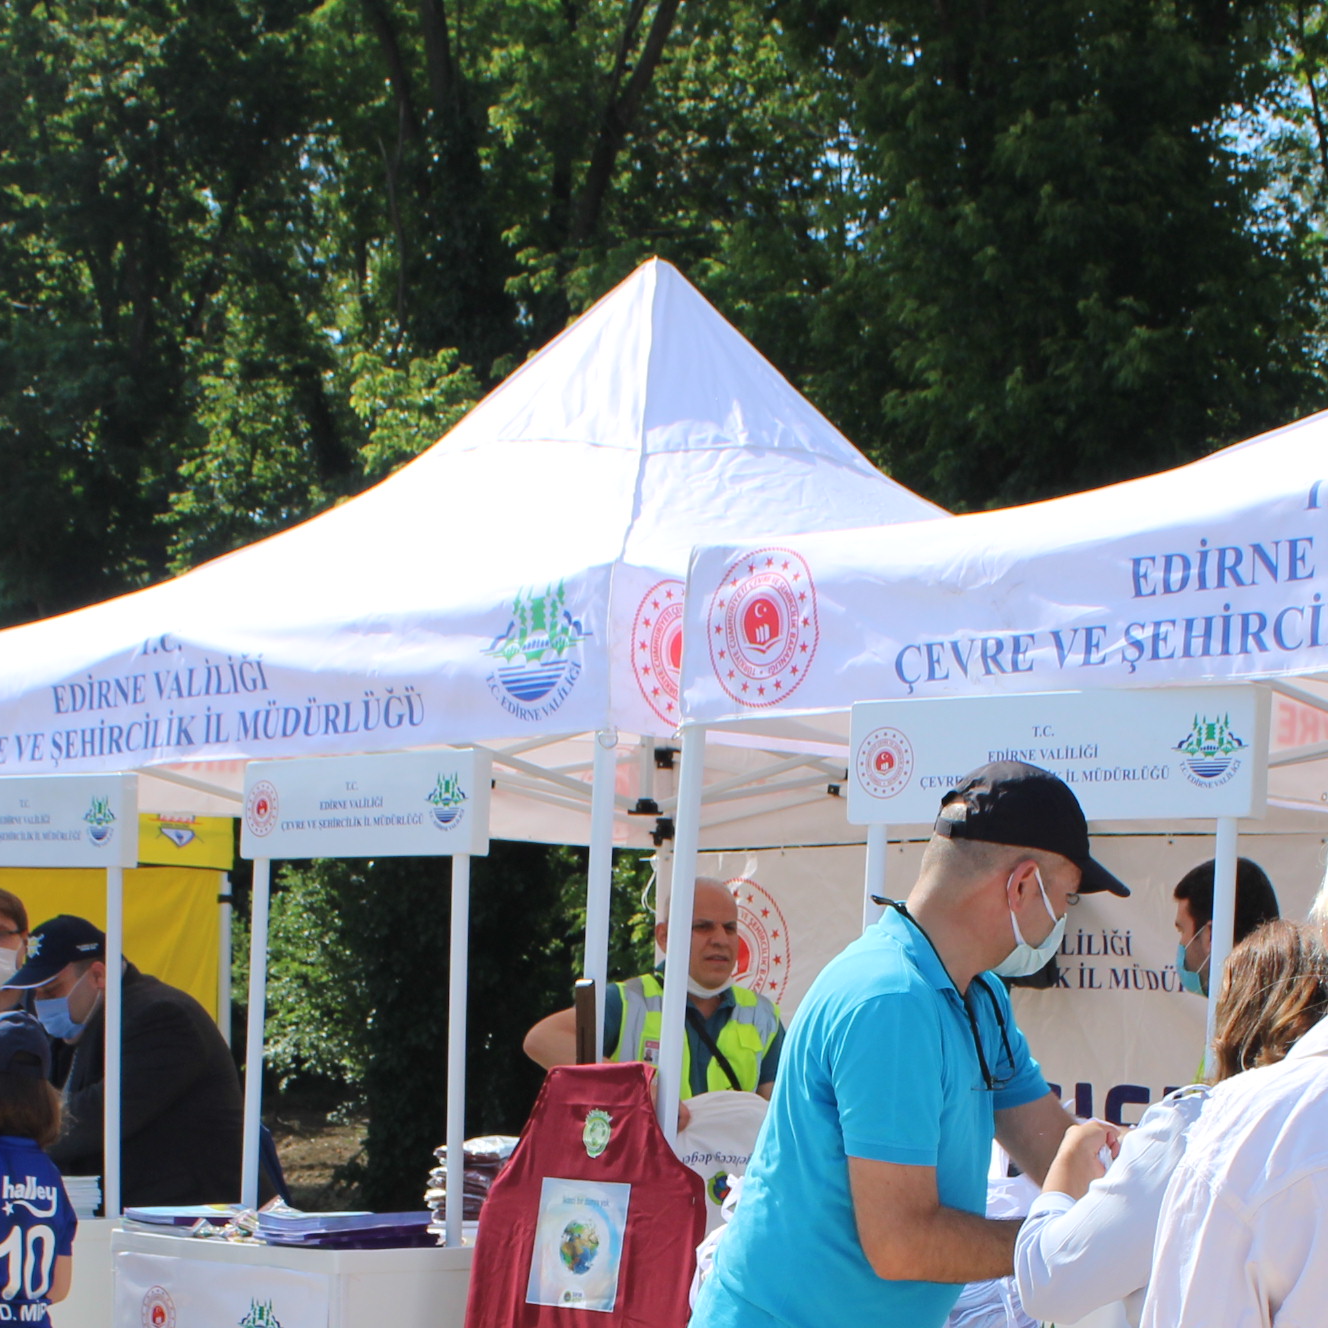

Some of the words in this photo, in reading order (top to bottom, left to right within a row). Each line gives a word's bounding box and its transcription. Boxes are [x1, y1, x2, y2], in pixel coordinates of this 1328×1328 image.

[1131, 535, 1315, 599] EDİRNE
[52, 674, 146, 714] EDİRNE
[153, 653, 270, 701] VALİLİĞİ
[895, 634, 1035, 695] ÇEVRE
[1050, 625, 1107, 669] VE
[15, 733, 44, 761] VE
[50, 710, 195, 767] ŞEHİRCİLİK
[204, 706, 230, 744] İL
[235, 686, 425, 743] MÜDÜRLÜĞÜ
[1032, 725, 1056, 738] T.C.
[1039, 743, 1100, 761] VALİLİĞİ
[1081, 764, 1171, 783] MÜDÜRLÜĞÜ
[2, 1175, 58, 1213] halley
